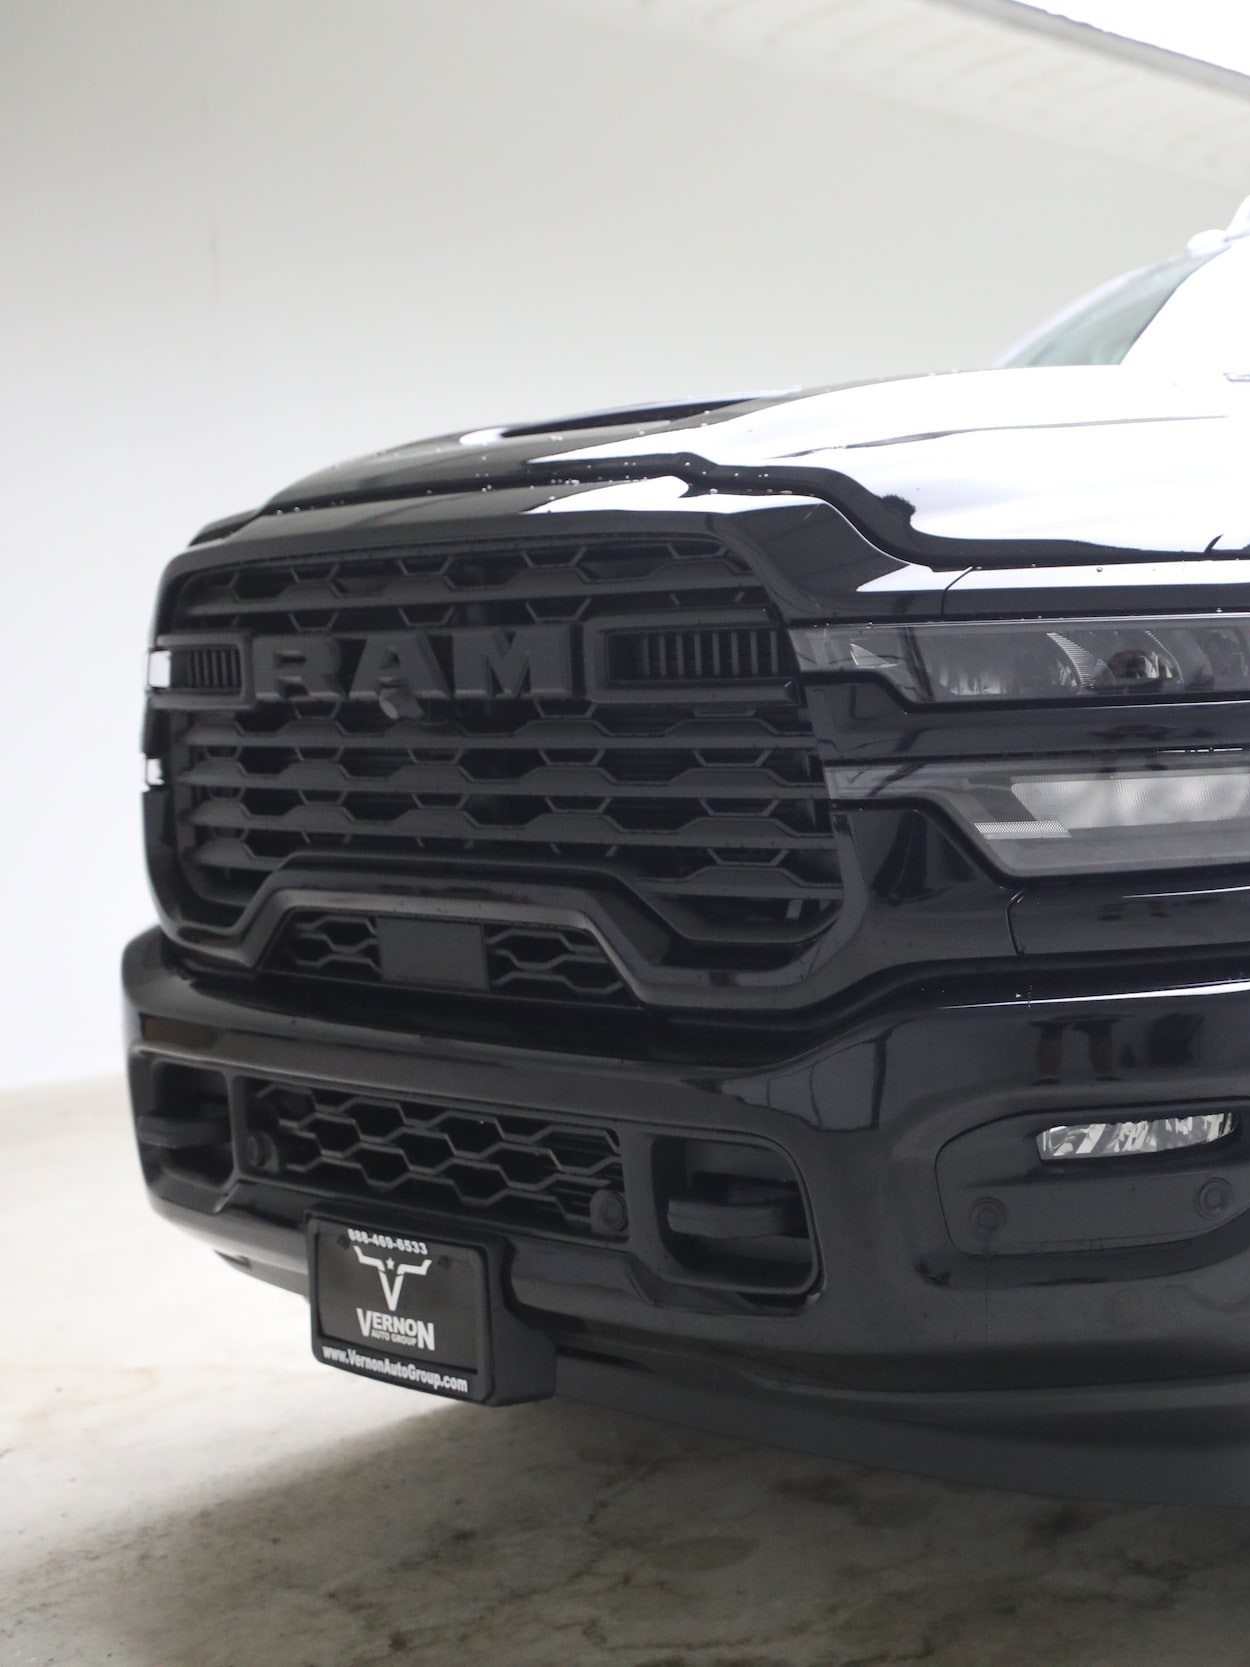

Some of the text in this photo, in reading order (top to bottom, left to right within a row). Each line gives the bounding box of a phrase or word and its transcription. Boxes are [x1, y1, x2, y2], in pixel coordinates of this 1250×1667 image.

[252, 625, 571, 701] RAM
[356, 1308, 435, 1351] VERNON
[371, 1329, 417, 1347] AUTO GROUP
[322, 1346, 468, 1393] www.VernonAutoGroup.com
